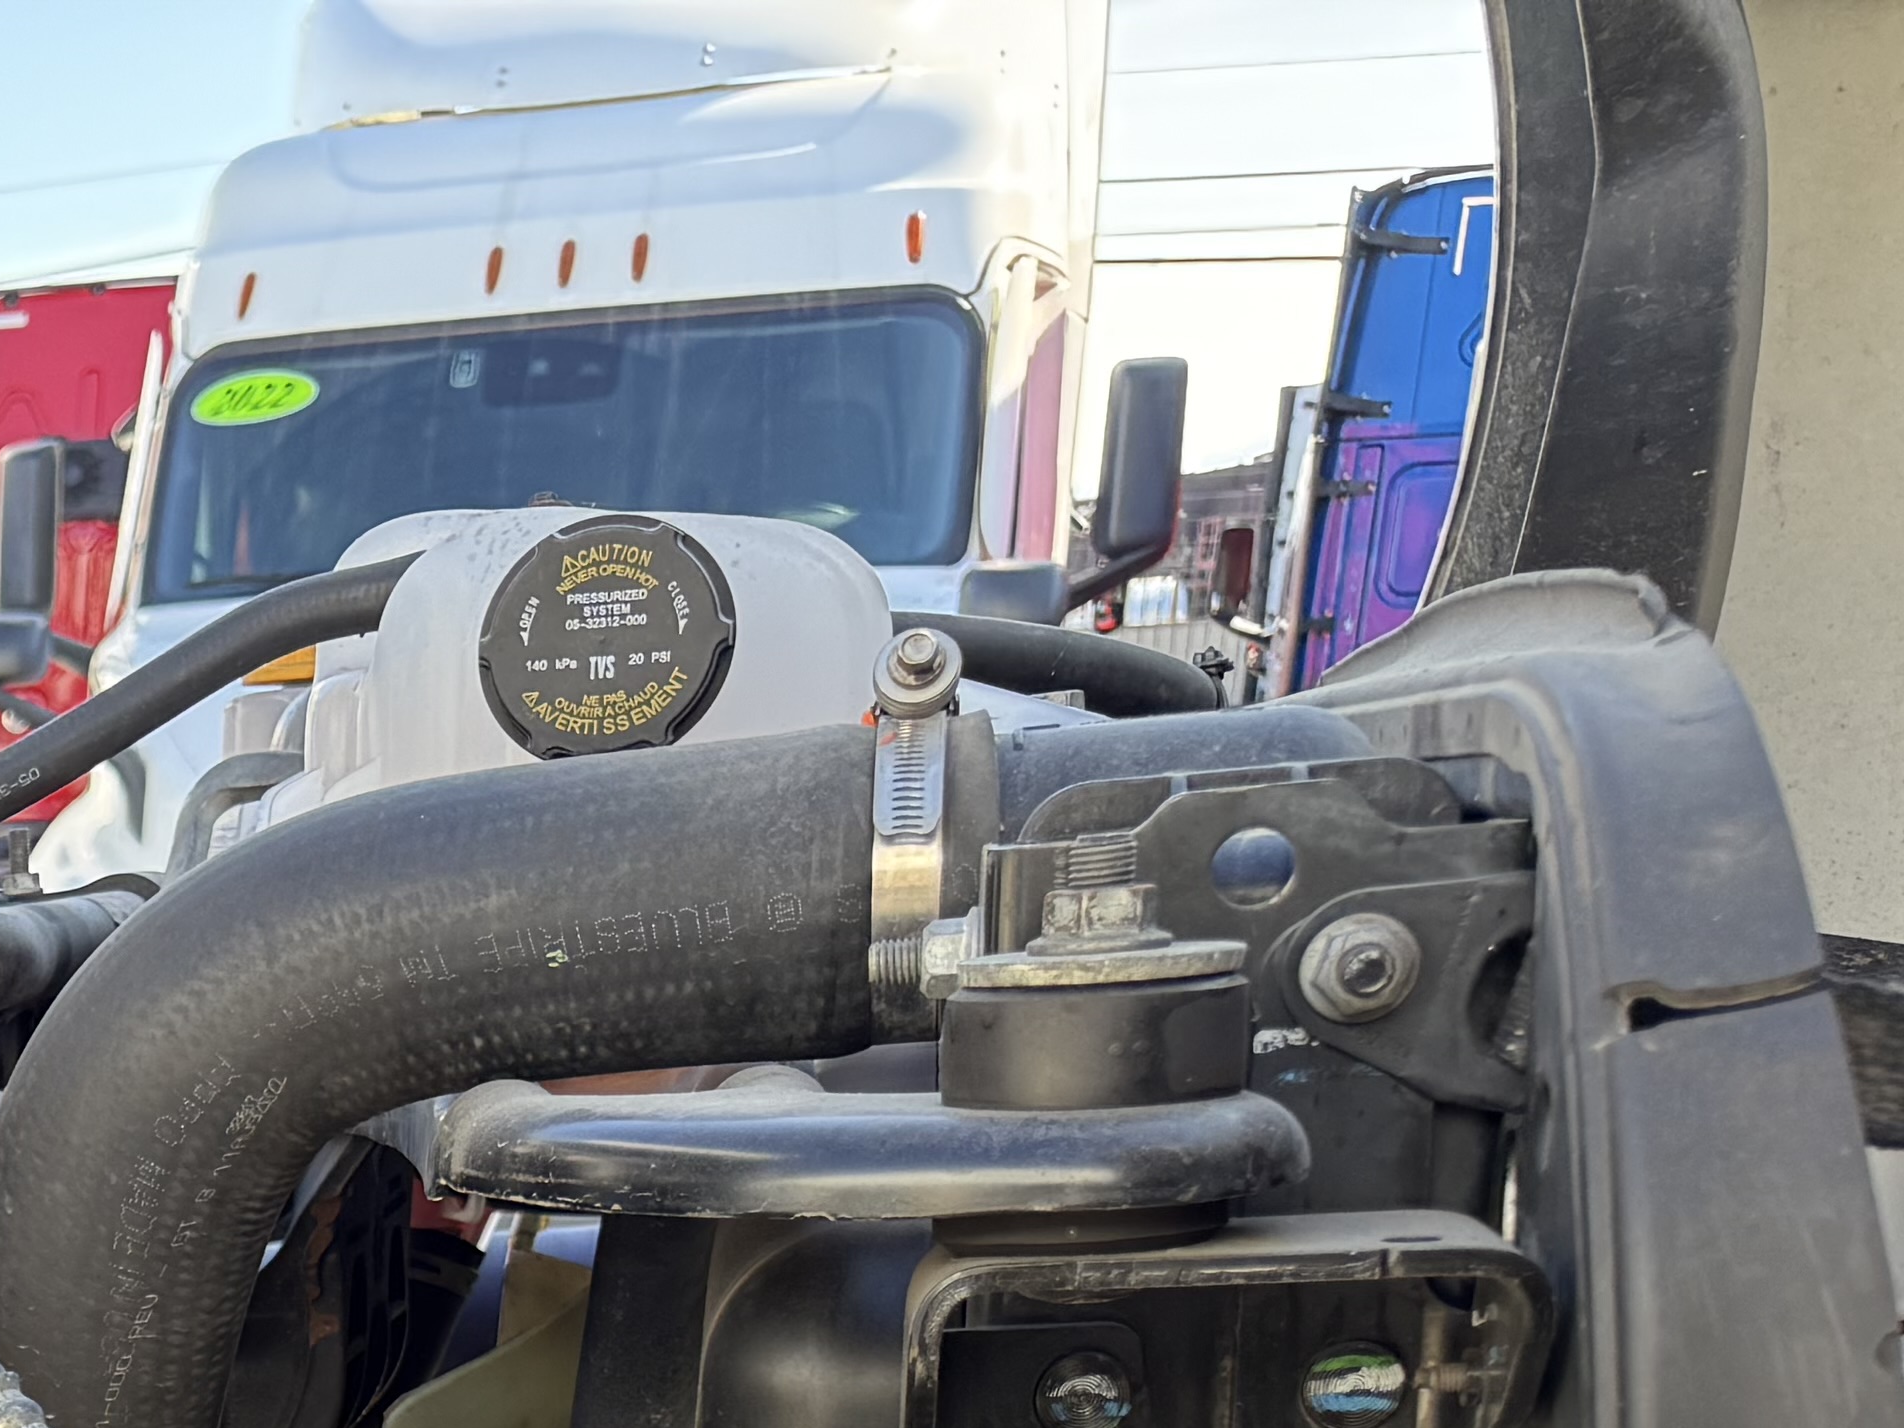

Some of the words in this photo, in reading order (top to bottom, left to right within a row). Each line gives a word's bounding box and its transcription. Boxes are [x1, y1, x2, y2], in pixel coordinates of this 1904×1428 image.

[578, 544, 653, 568] CAUTION
[556, 568, 598, 595] NEVER
[599, 565, 636, 580] OPEN
[634, 570, 659, 590] HOT
[566, 589, 648, 605] PRESSURIZED
[667, 580, 690, 618] CLOSE
[519, 597, 540, 629] OPEN
[583, 604, 631, 616] SYSTEM
[565, 614, 647, 631] 05-32312-000
[526, 660, 547, 671] 140
[555, 658, 578, 670] kPa
[589, 655, 615, 680] TVS
[628, 653, 644, 665] 20
[651, 651, 671, 664] PSI
[555, 697, 603, 718] OUVRIR
[614, 681, 659, 714] CHAUD
[582, 694, 599, 706] NE
[603, 690, 627, 705] PAS
